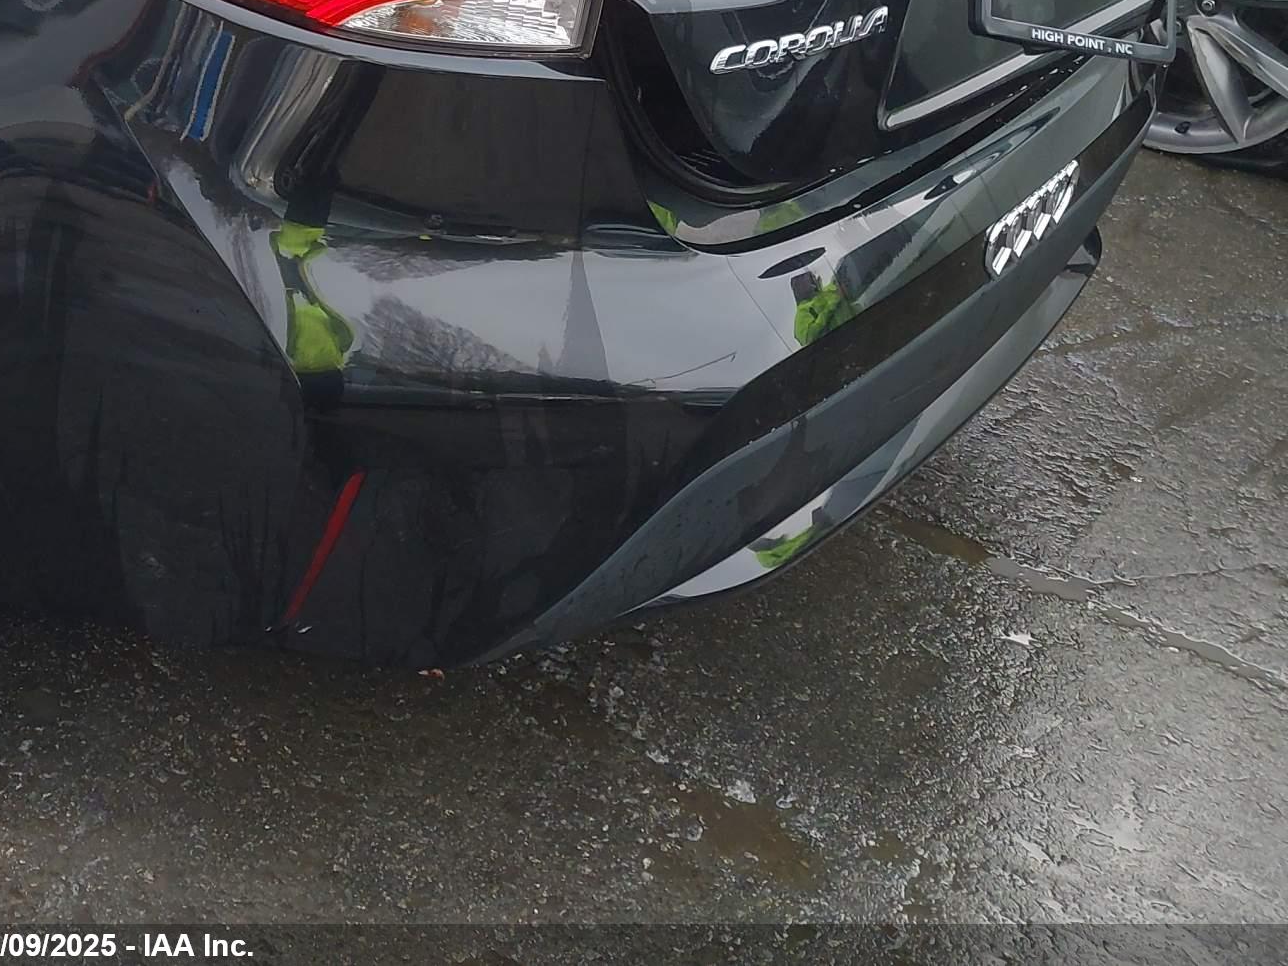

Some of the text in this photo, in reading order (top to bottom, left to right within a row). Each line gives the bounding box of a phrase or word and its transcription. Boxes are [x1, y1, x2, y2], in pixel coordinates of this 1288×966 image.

[709, 6, 889, 75] COROLLA
[1032, 28, 1064, 43] HIGH
[1115, 42, 1133, 54] NC
